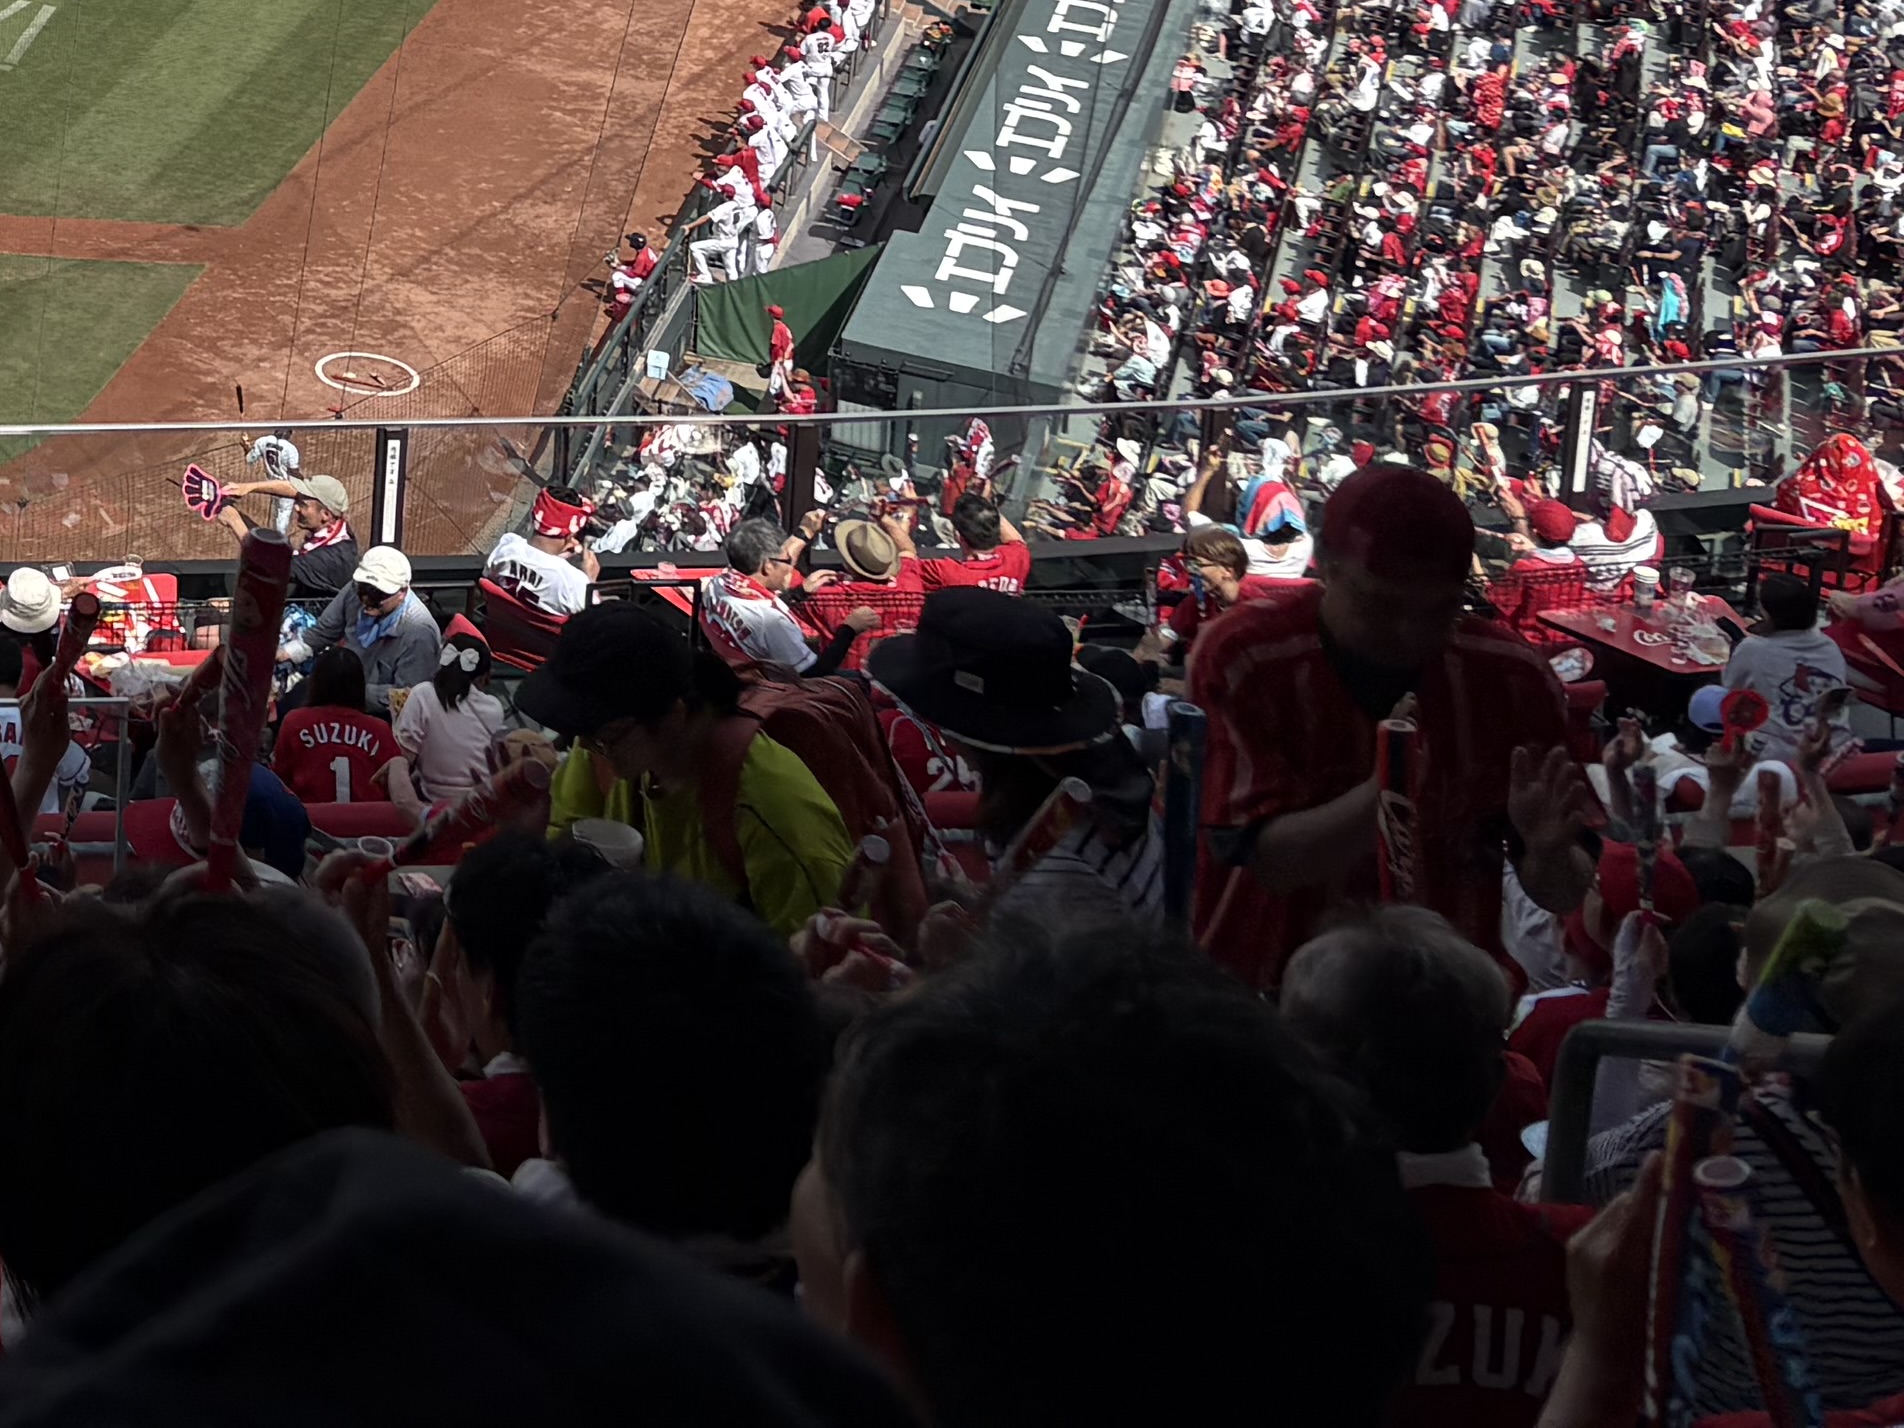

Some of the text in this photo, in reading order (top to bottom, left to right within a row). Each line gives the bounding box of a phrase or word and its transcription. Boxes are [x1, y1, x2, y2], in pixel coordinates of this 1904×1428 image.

[995, 62, 1091, 161] エブリイ
[933, 182, 1041, 295] エブリイ
[297, 722, 380, 758] SUZUKI
[328, 755, 352, 803] 1
